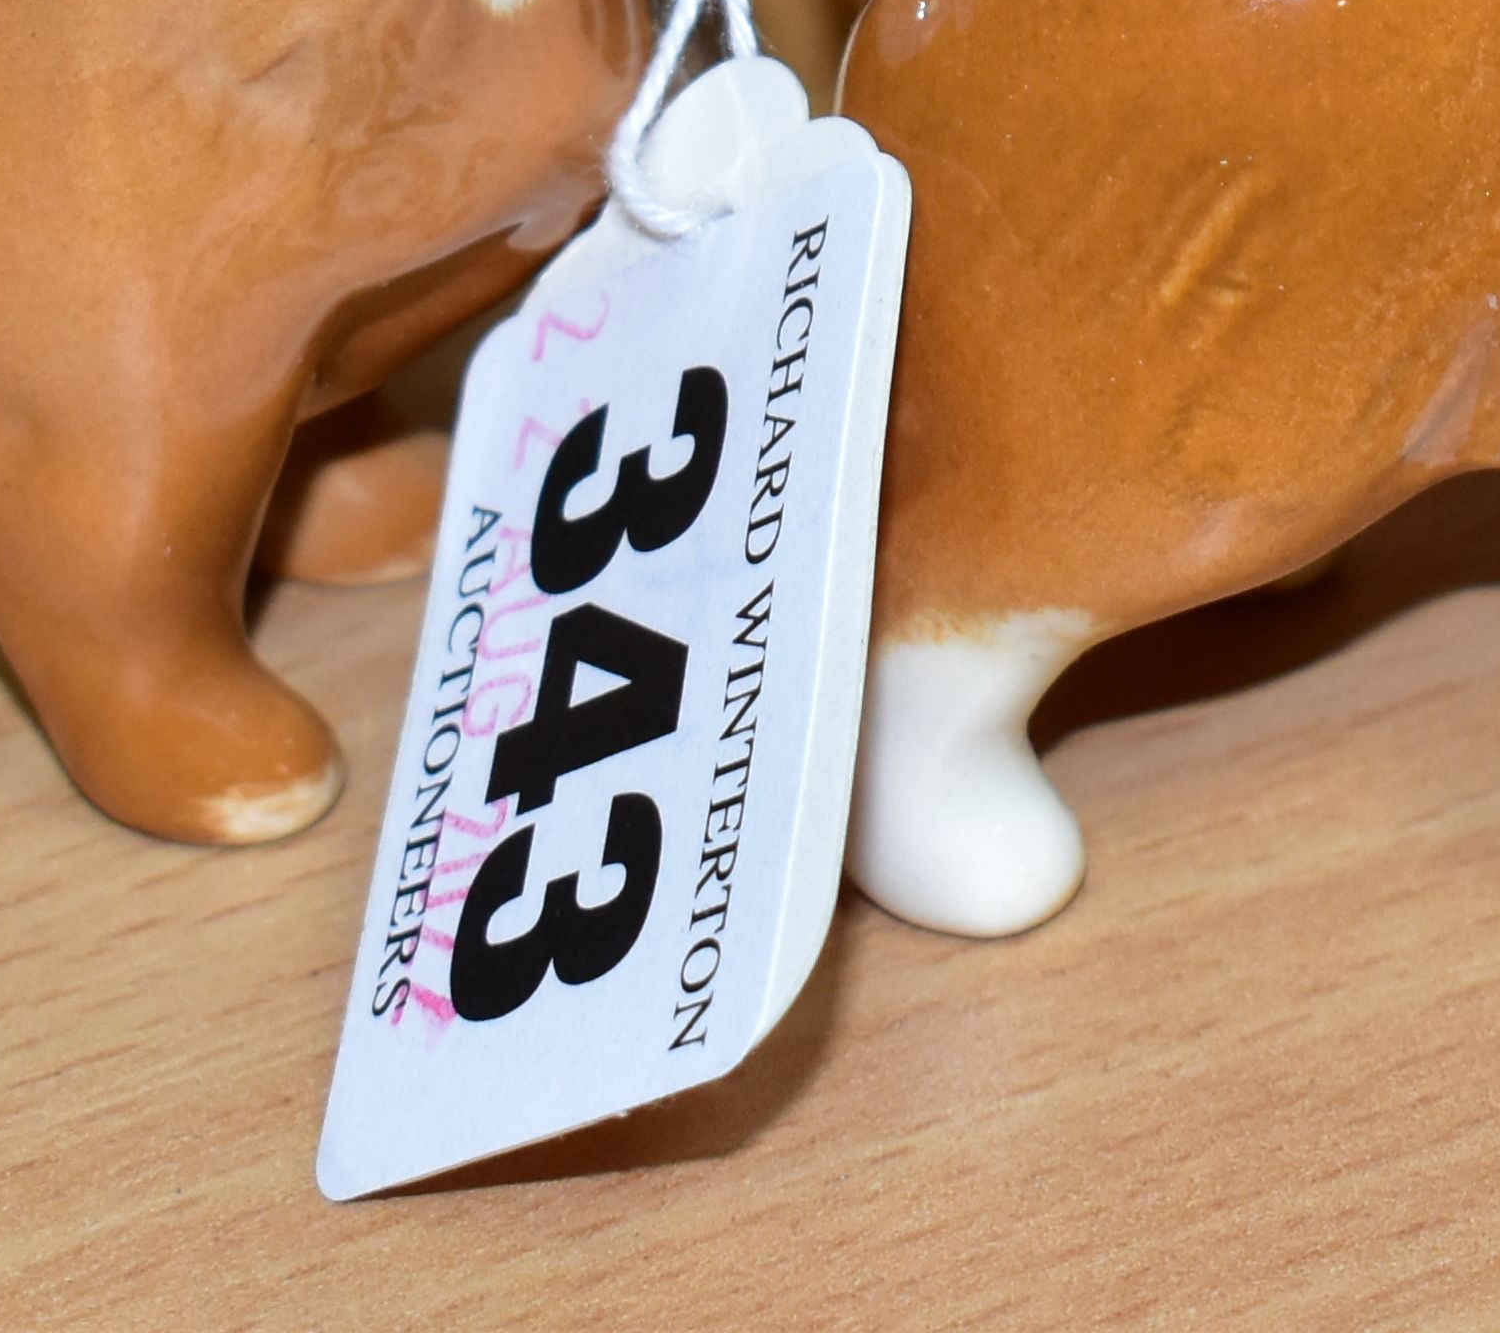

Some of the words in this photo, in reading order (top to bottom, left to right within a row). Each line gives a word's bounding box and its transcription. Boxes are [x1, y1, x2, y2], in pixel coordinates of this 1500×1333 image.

[745, 215, 829, 566] RICHARD
[372, 503, 503, 1018] AUCTIONEERS
[448, 364, 729, 1023] 343
[463, 523, 551, 738] AUG
[668, 576, 776, 1052] WINTERTON
